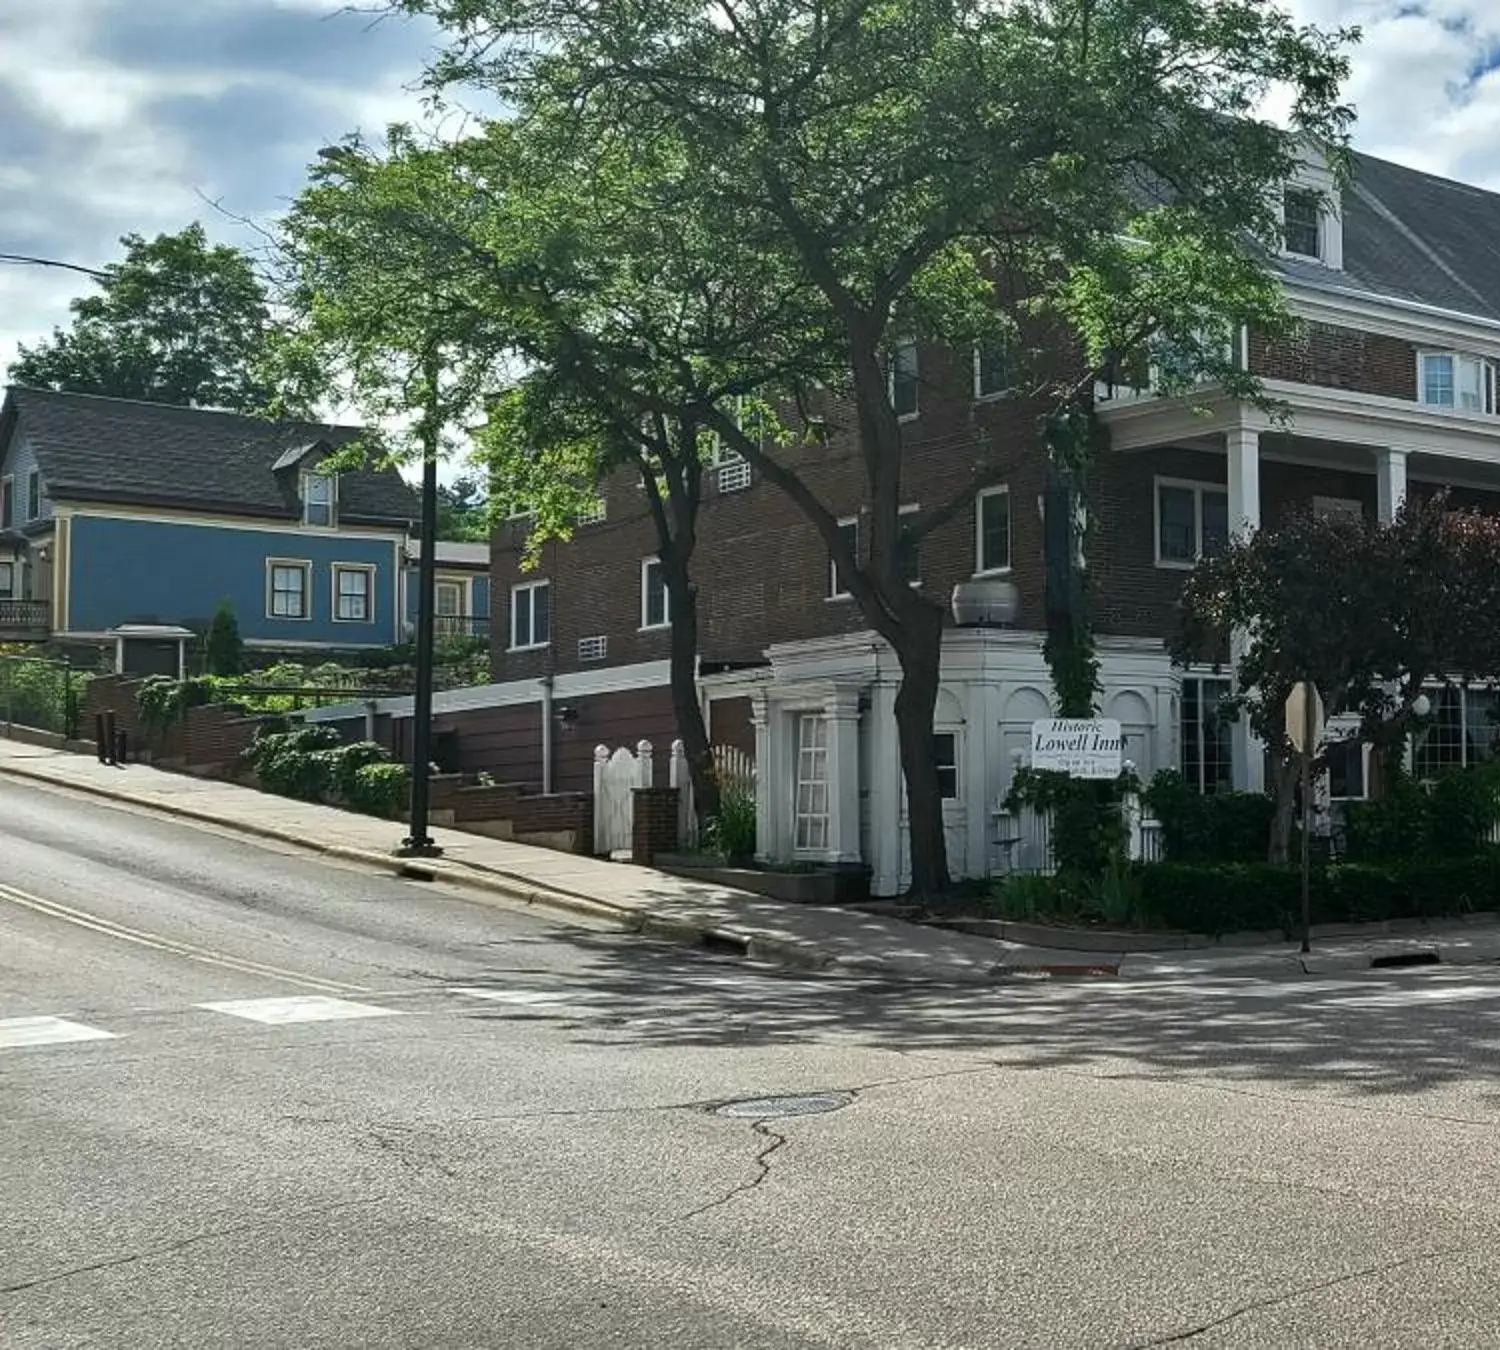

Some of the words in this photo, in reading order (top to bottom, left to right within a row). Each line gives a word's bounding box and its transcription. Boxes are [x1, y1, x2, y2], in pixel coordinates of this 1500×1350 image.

[1051, 721, 1103, 732] Historic
[1035, 734, 1089, 751] Lowell
[1092, 734, 1120, 751] Inn
